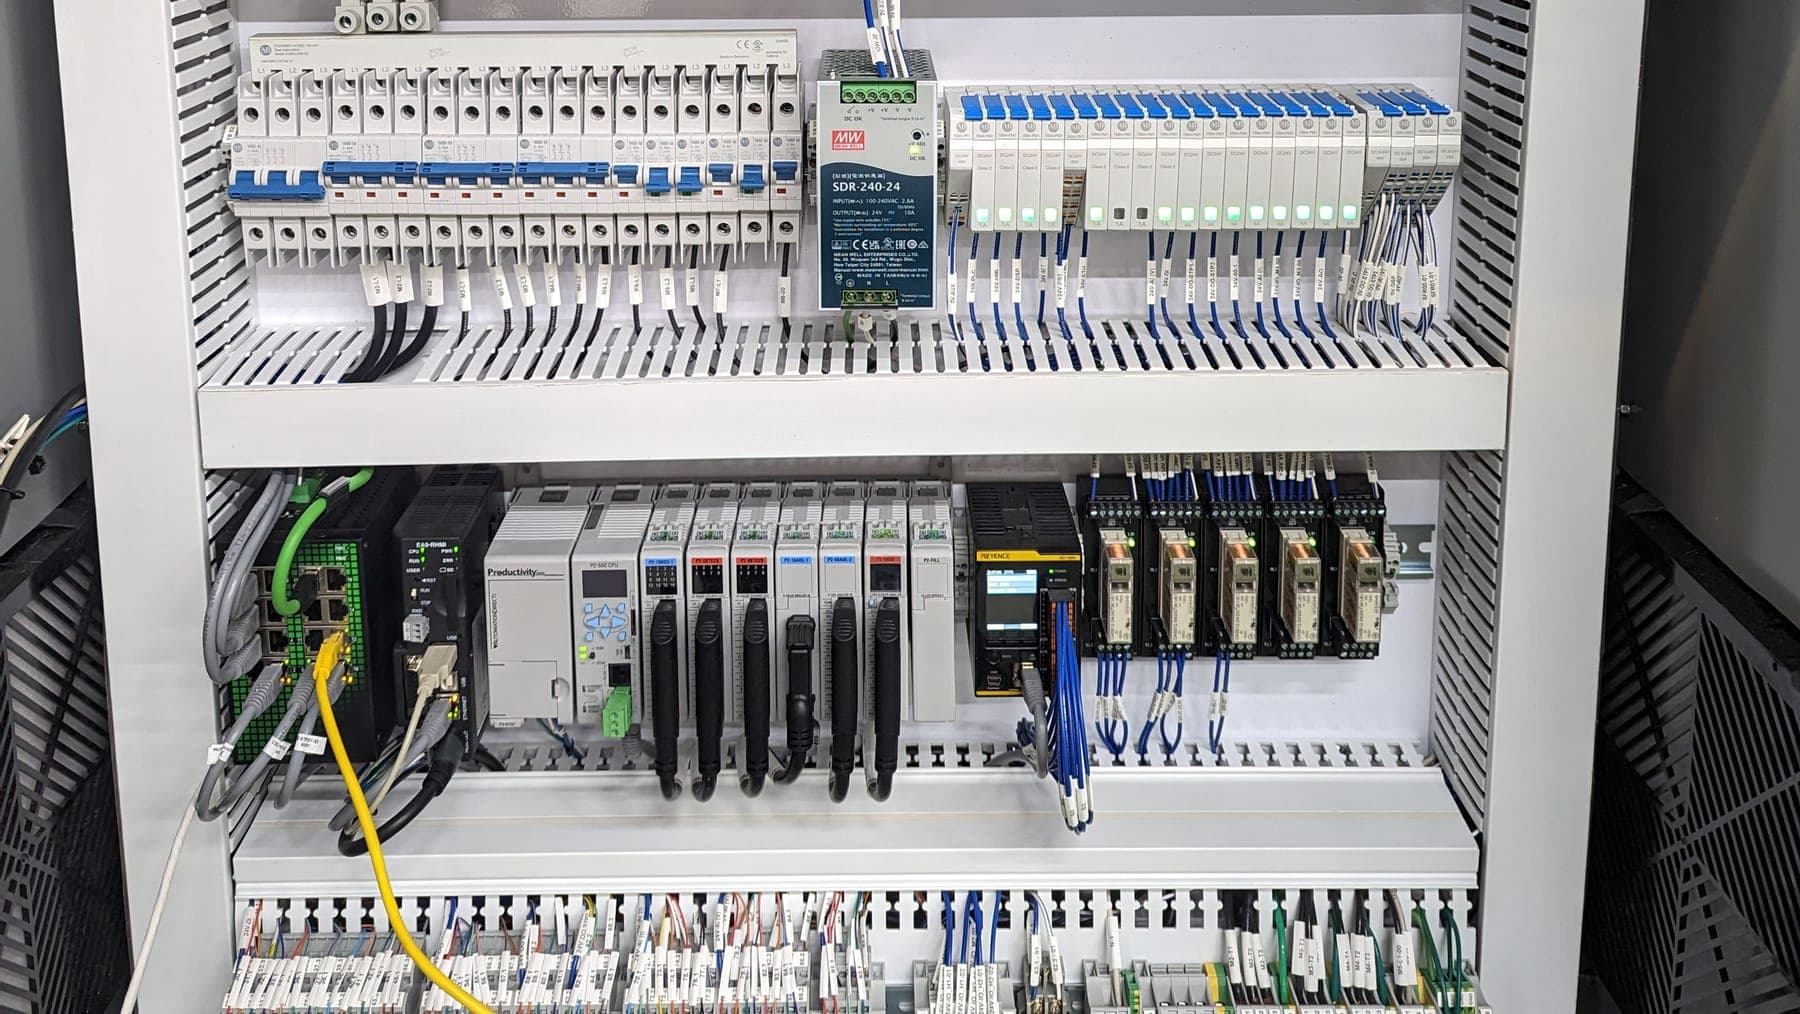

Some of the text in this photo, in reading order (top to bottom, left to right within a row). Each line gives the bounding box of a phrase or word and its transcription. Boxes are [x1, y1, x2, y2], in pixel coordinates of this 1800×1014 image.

[834, 132, 862, 142] MW
[832, 182, 900, 192] SDR-240-24
[488, 568, 537, 577] Productivity
